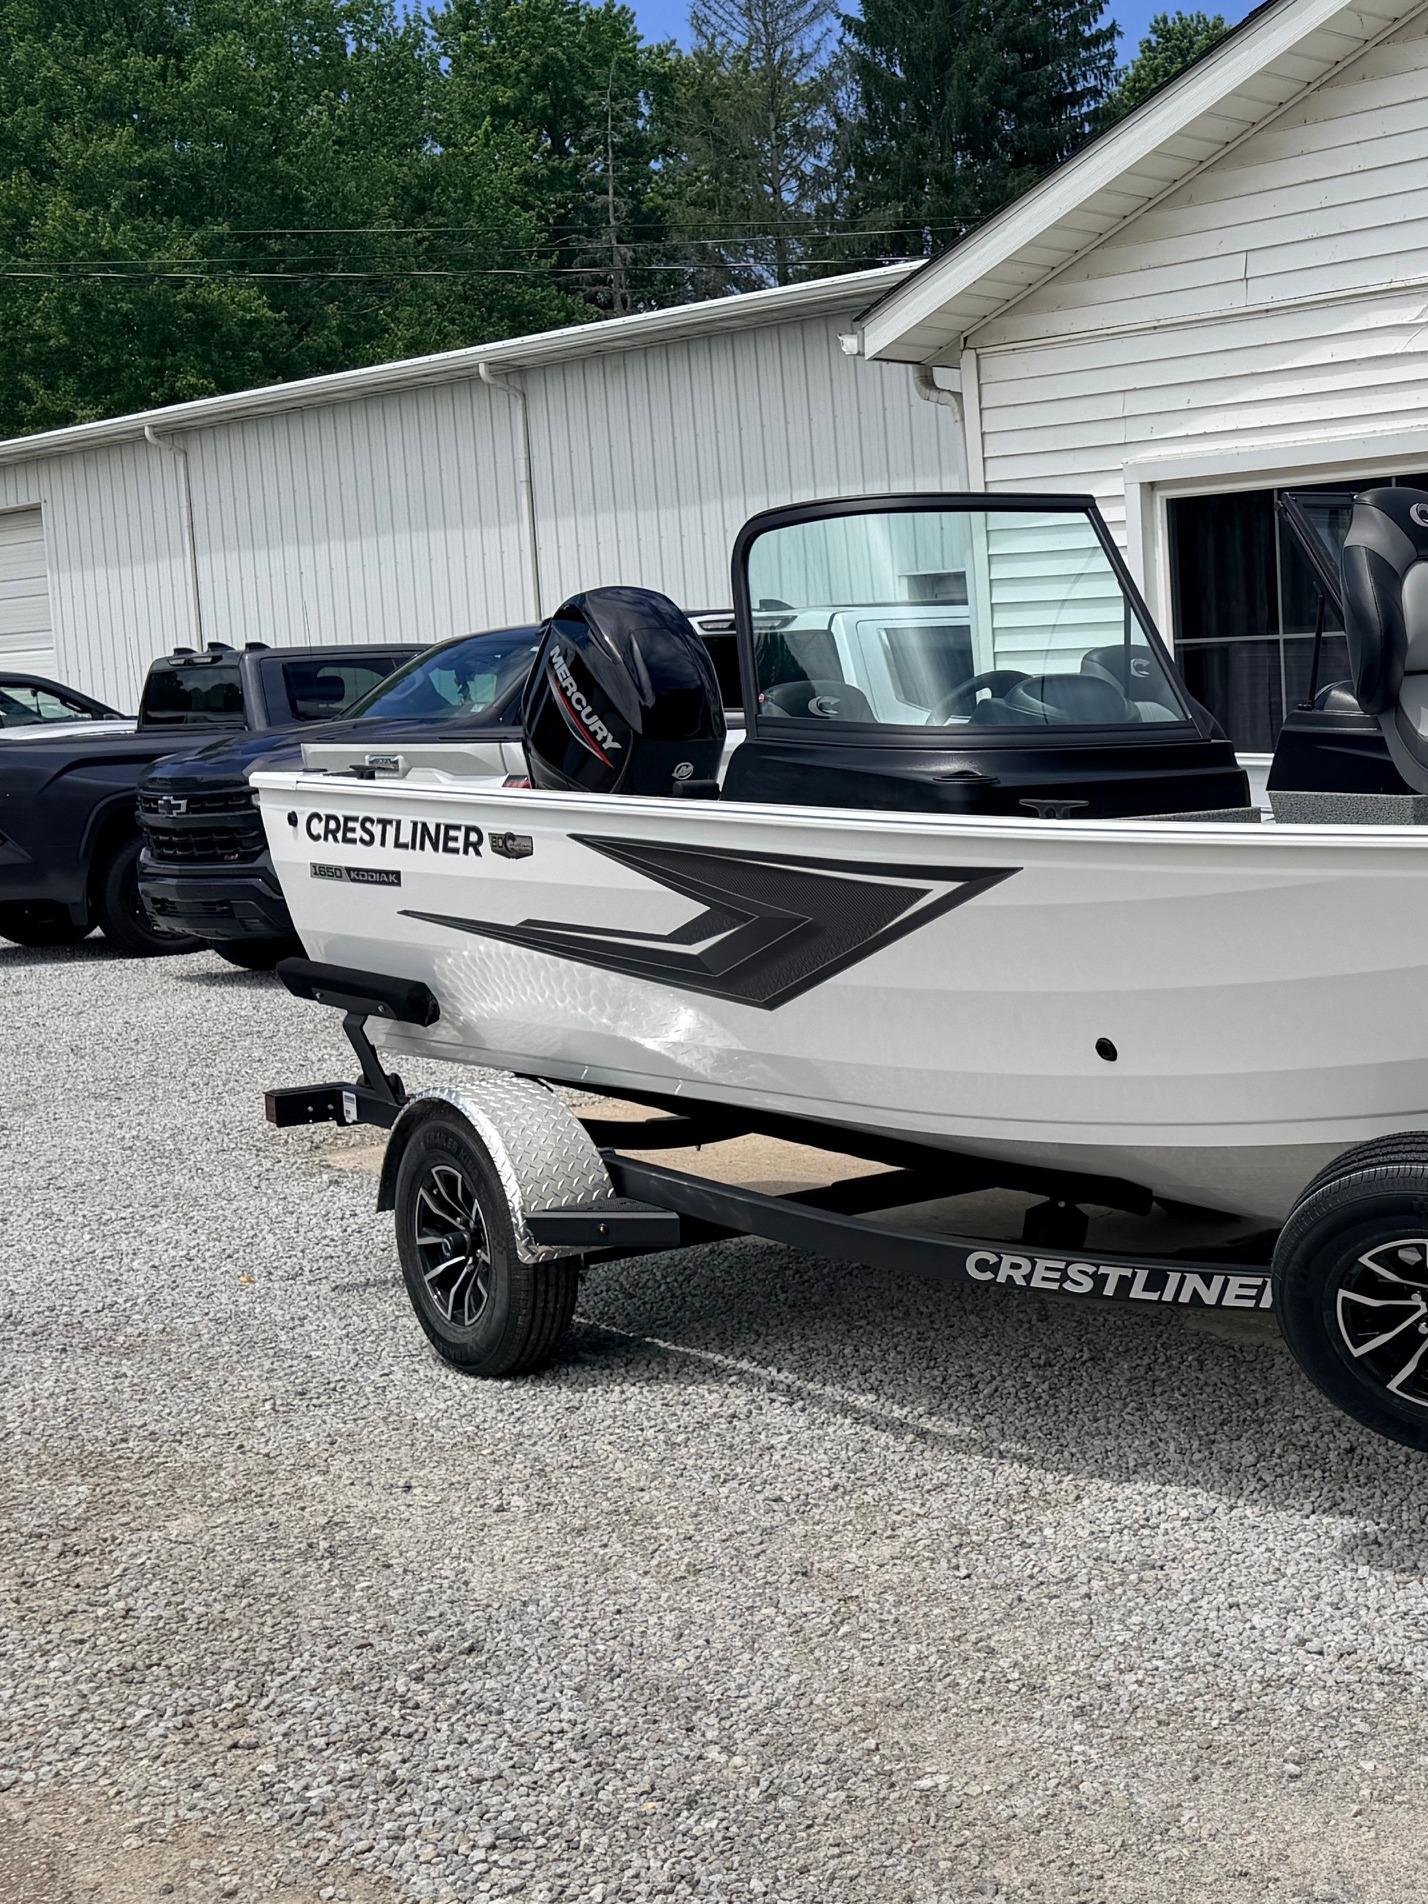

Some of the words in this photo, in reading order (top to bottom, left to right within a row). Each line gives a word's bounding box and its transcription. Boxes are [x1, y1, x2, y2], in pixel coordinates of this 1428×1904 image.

[549, 645, 622, 751] MERCURY
[305, 811, 484, 858] CRESTLINER
[311, 864, 343, 879] 1650
[350, 869, 399, 884] KODIAK
